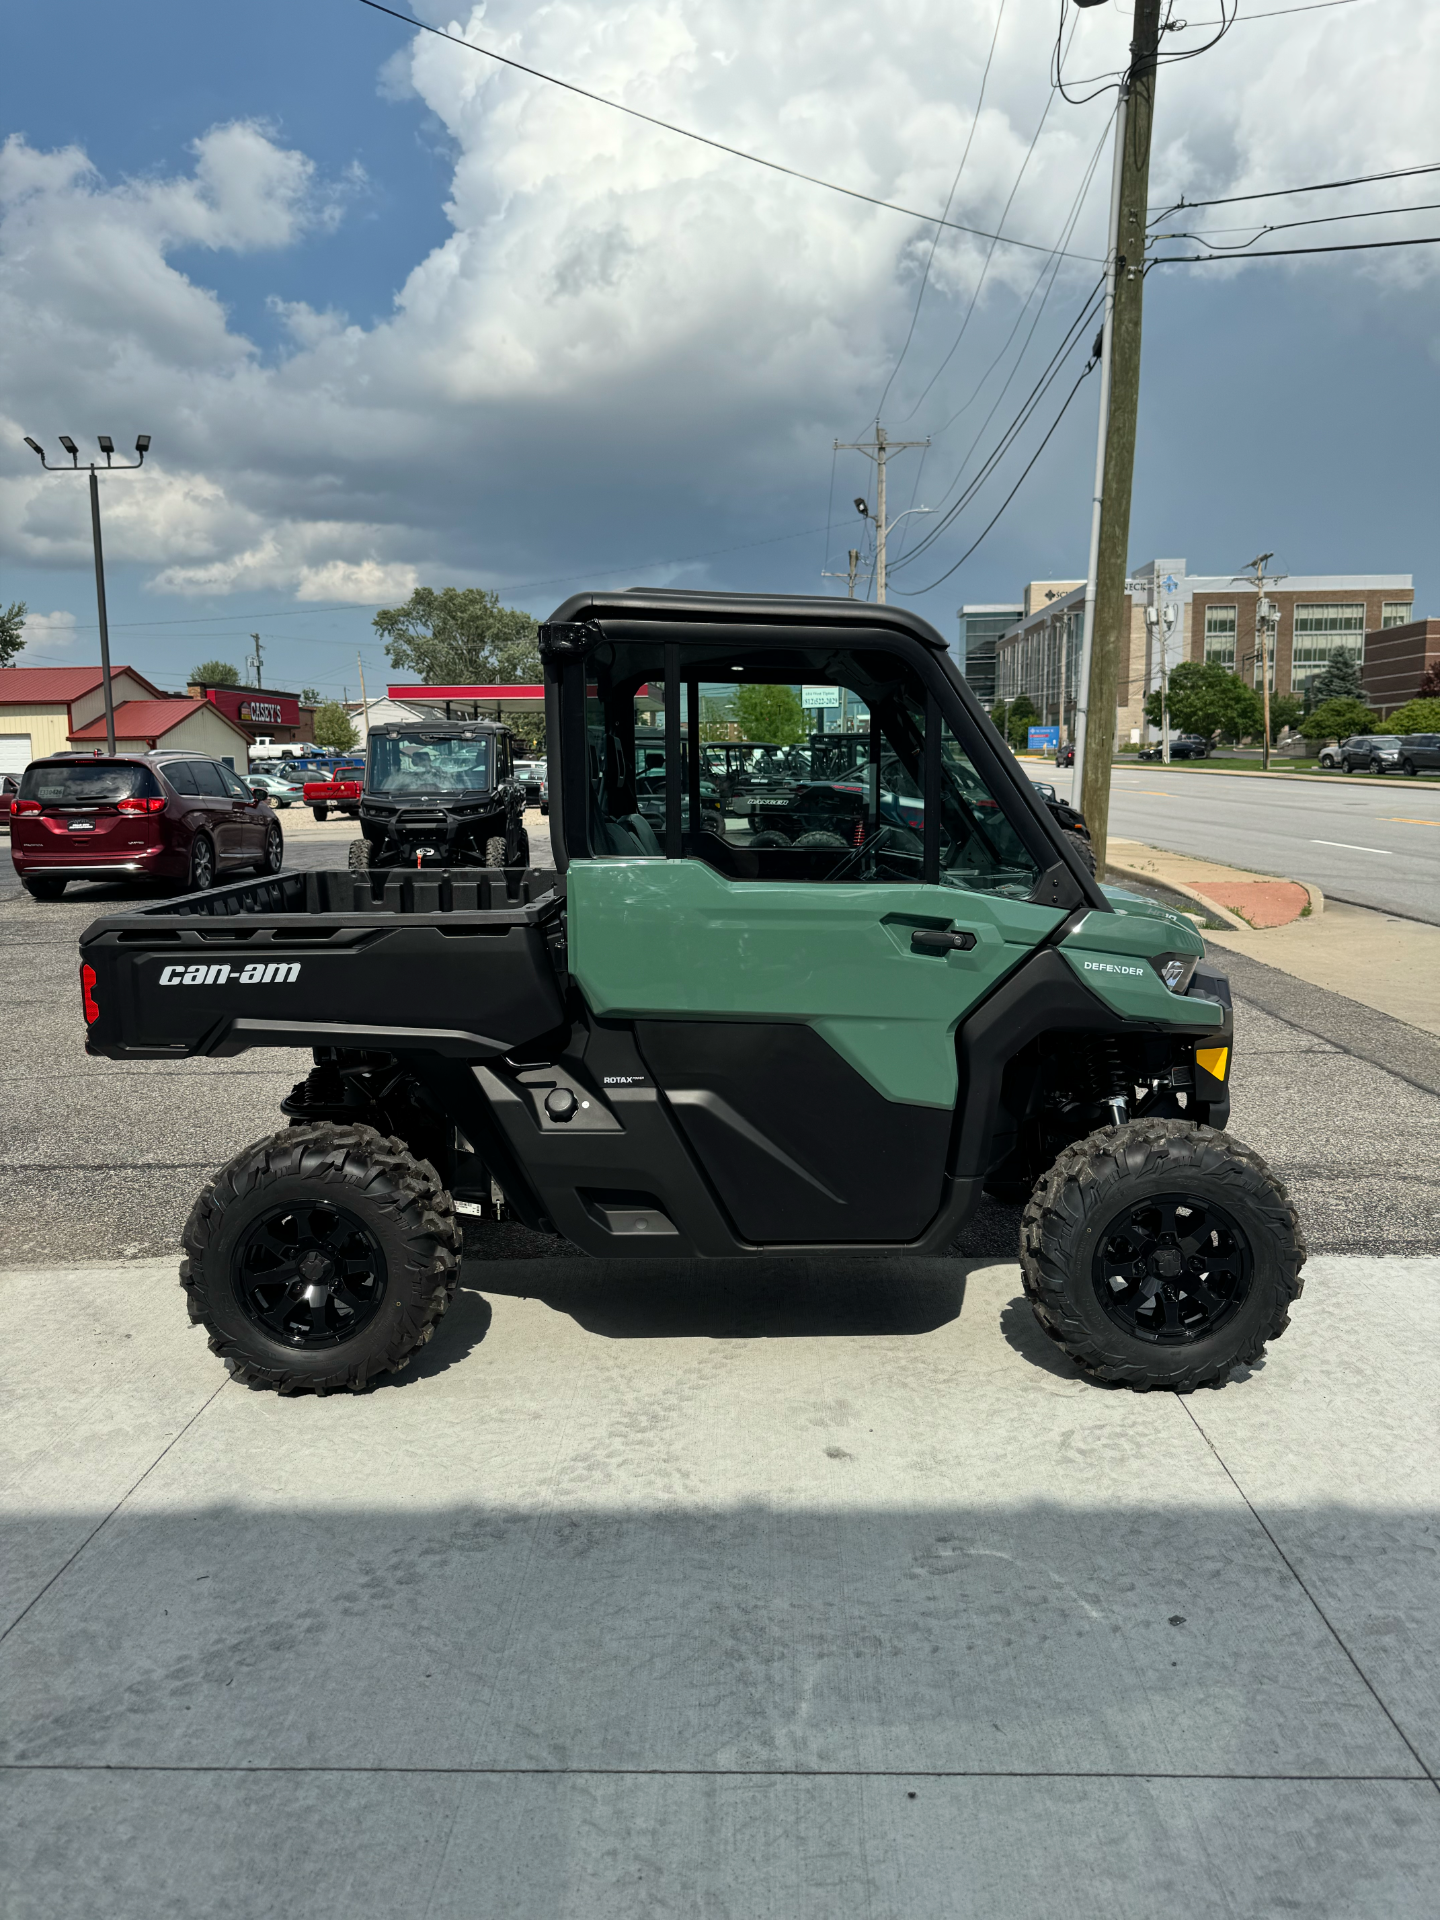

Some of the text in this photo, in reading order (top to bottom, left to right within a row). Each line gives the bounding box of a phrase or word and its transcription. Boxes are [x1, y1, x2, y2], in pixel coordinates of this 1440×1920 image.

[251, 701, 282, 723] CASEY'S
[158, 962, 302, 986] can-am
[1084, 961, 1144, 976] DEFENDER
[603, 1076, 633, 1084] ROTAX
